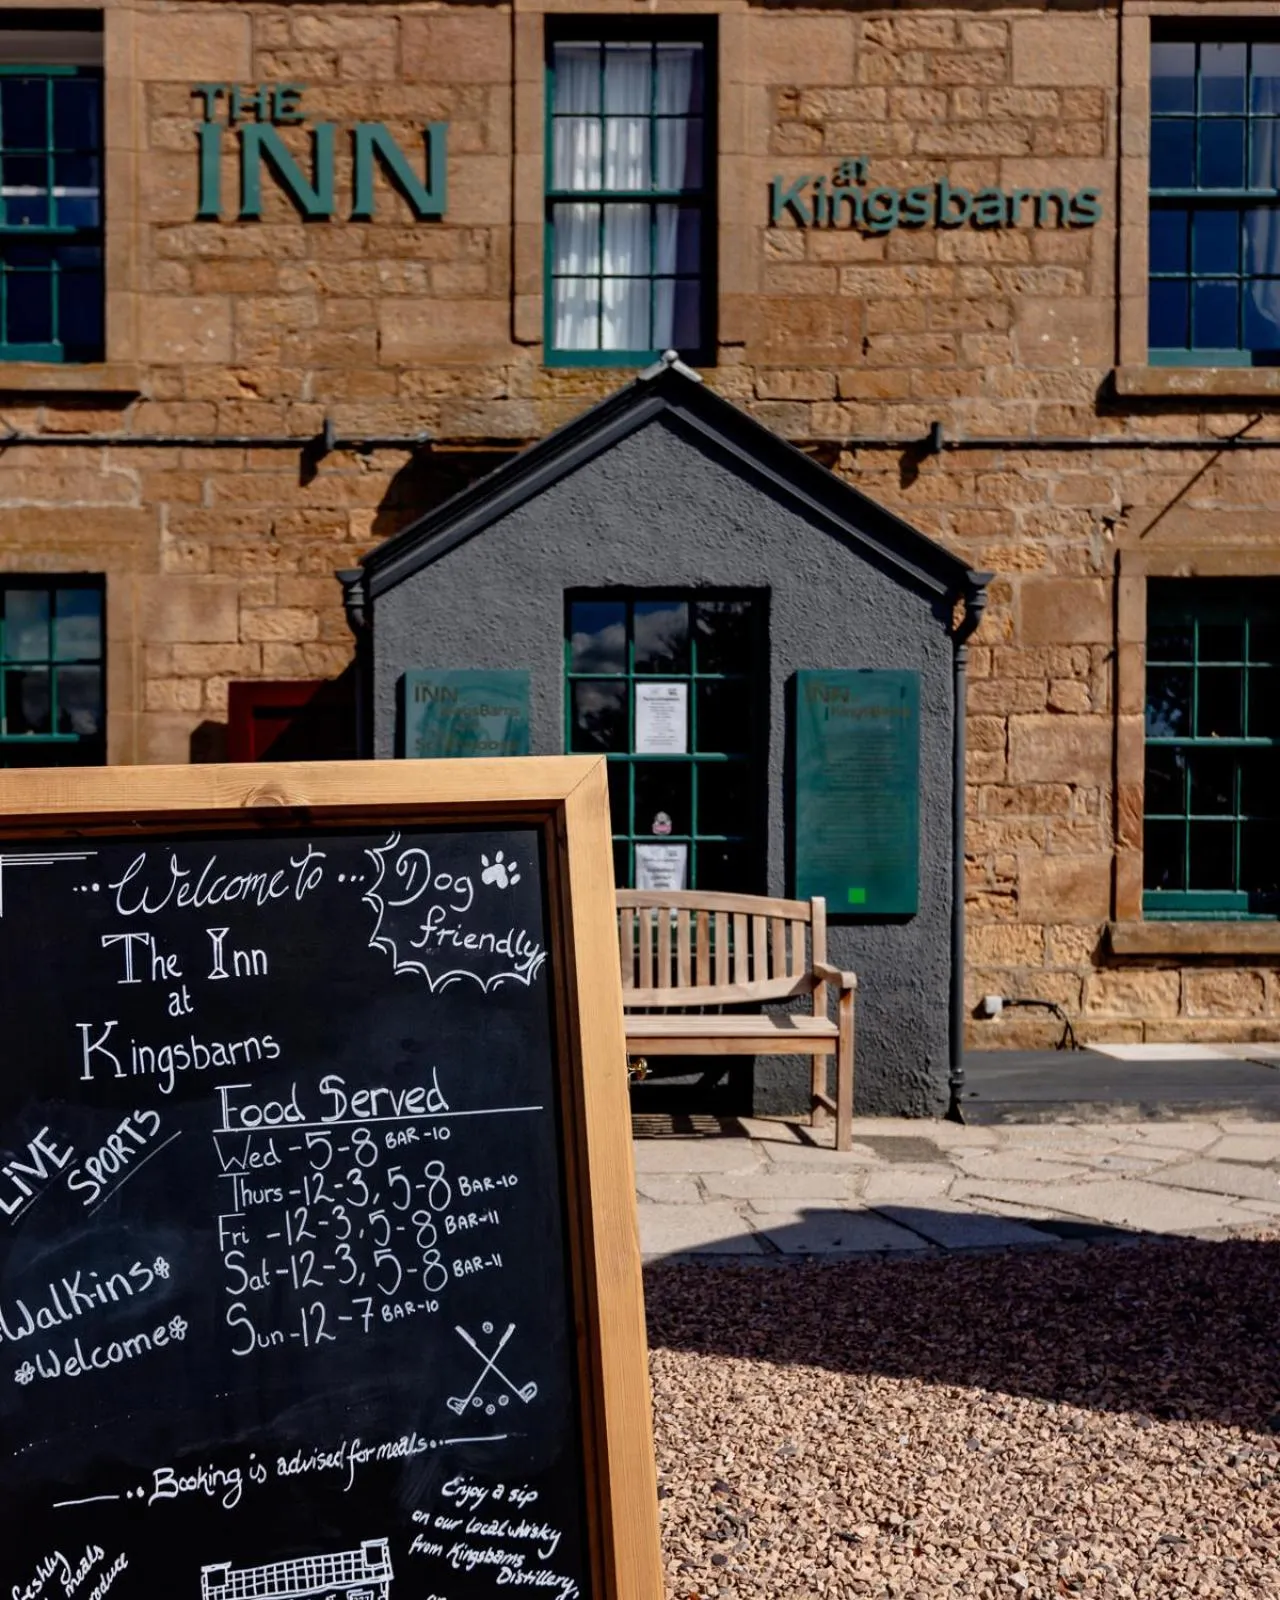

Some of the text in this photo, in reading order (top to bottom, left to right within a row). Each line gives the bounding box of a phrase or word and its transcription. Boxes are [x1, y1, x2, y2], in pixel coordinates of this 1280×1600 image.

[192, 83, 308, 124] THE
[196, 121, 448, 221] INN
[834, 155, 868, 186] at
[769, 174, 1103, 237] Kingsbarns
[414, 686, 459, 703] INN
[388, 848, 474, 912] Dog
[101, 927, 269, 983] The Inn
[410, 905, 541, 972] friendly
[168, 984, 194, 1017] at
[75, 1020, 281, 1094] Kingsbarns
[214, 1066, 450, 1129] Food Served
[67, 1109, 161, 1206] SPORTS
[213, 1134, 282, 1171] Wed
[218, 1172, 284, 1212] Thurs
[218, 1213, 250, 1251] Fri
[224, 1250, 271, 1295] Sat
[36, 1326, 170, 1379] Welcome
[226, 1302, 285, 1356] Sun
[249, 1453, 267, 1483] is
[277, 1440, 346, 1476] advised
[344, 1438, 375, 1491] for
[441, 1475, 539, 1512] Enjoy a sip
[408, 1533, 444, 1556] from
[411, 1510, 430, 1525] on
[434, 1516, 464, 1531] our
[508, 1519, 562, 1560] whisky
[65, 1545, 105, 1598] meals
